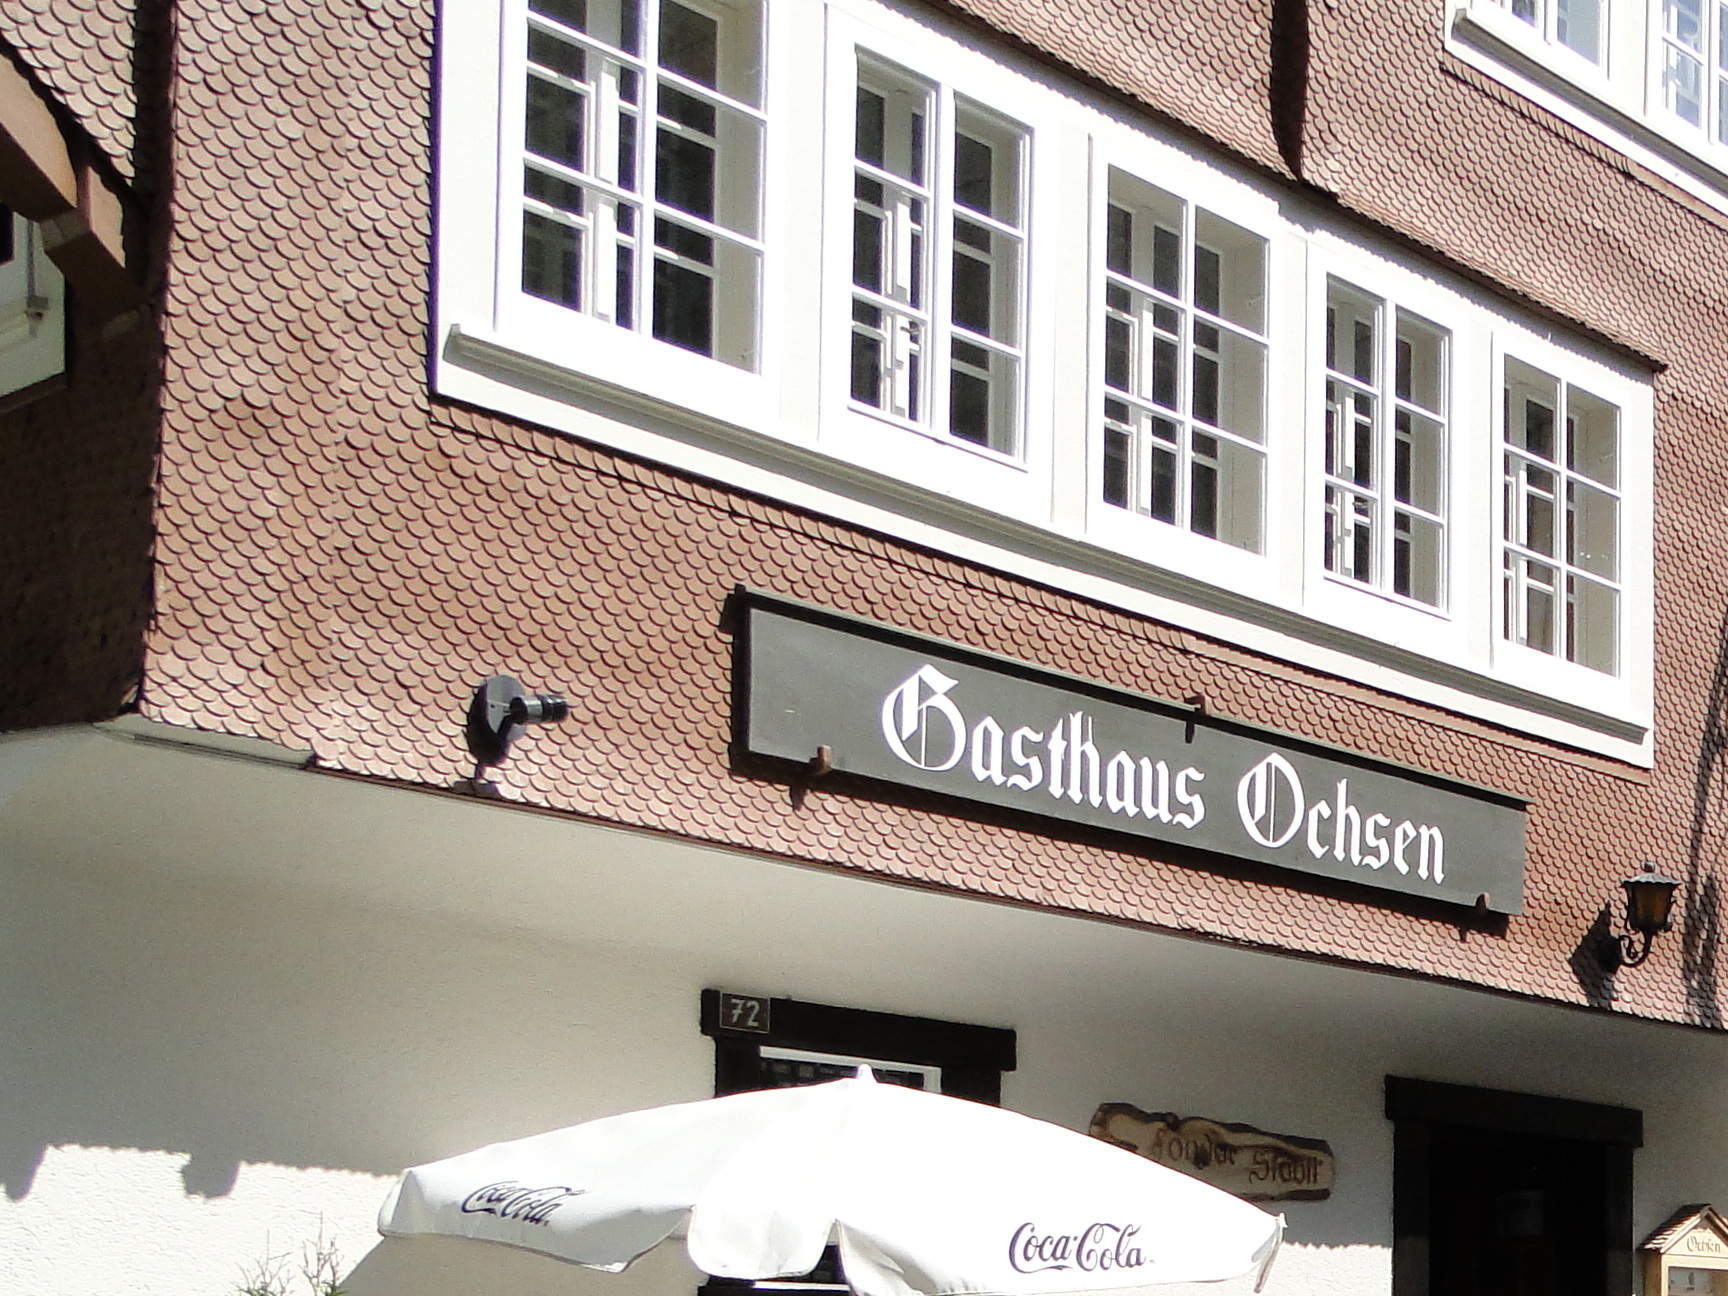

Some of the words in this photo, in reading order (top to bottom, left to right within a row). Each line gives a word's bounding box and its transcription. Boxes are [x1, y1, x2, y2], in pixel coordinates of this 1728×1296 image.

[881, 663, 1205, 829] Gasthaus
[1236, 751, 1447, 884] Ochsen
[730, 998, 759, 1027] 72
[1008, 1222, 1156, 1274] Coca-Cola
